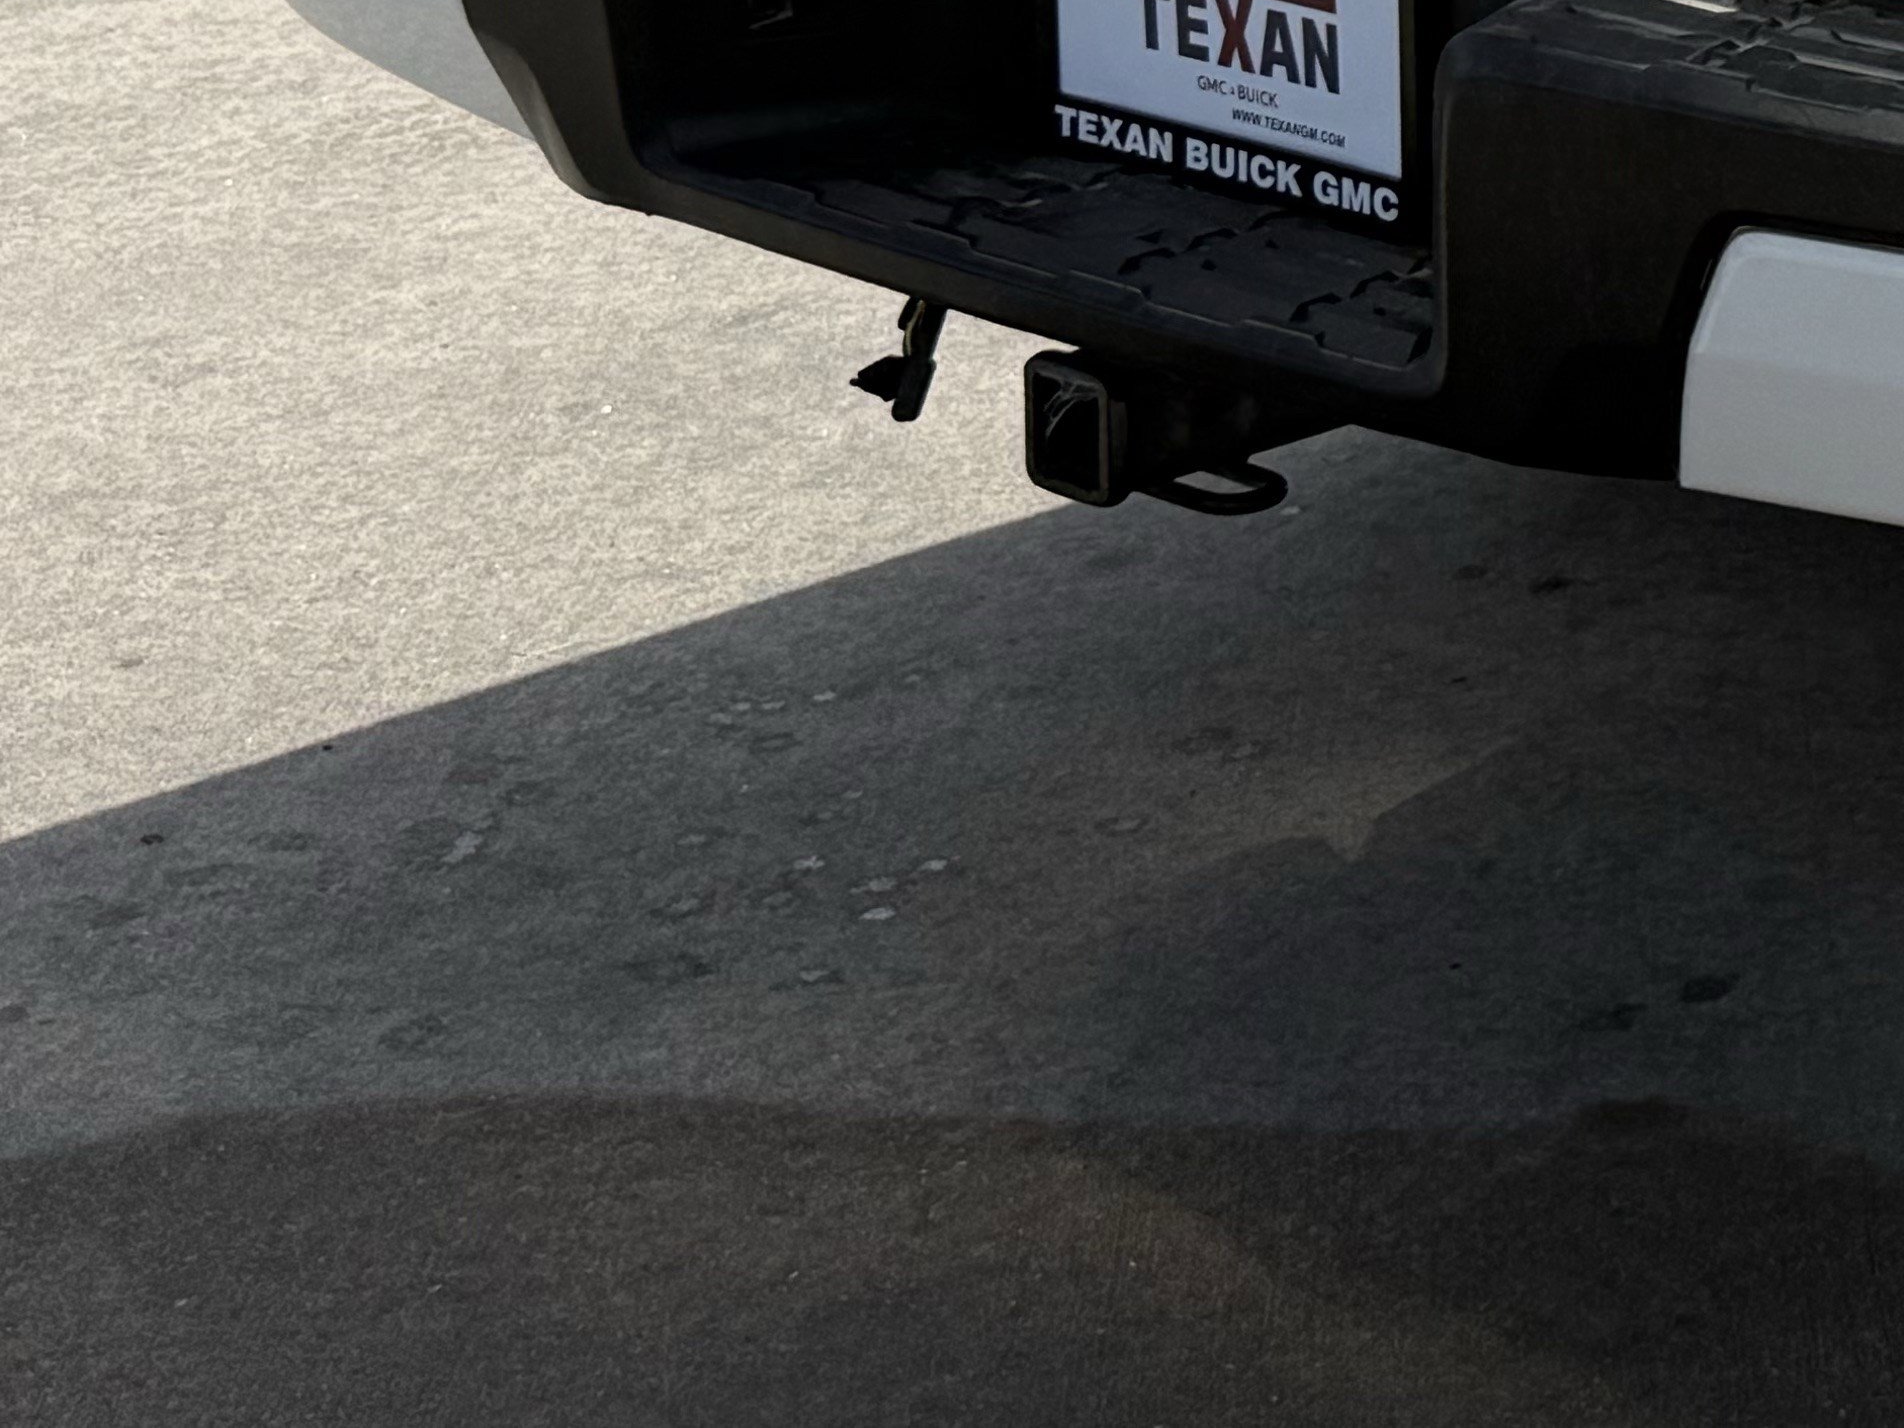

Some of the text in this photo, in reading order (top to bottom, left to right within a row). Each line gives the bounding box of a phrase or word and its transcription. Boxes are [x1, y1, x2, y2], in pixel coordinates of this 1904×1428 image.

[1196, 75, 1228, 96] GMC
[1237, 85, 1279, 109] BUICK
[1231, 107, 1347, 148] WWW.TEXANGM.COM
[1054, 104, 1400, 223] TEXAN BUICK GMC
